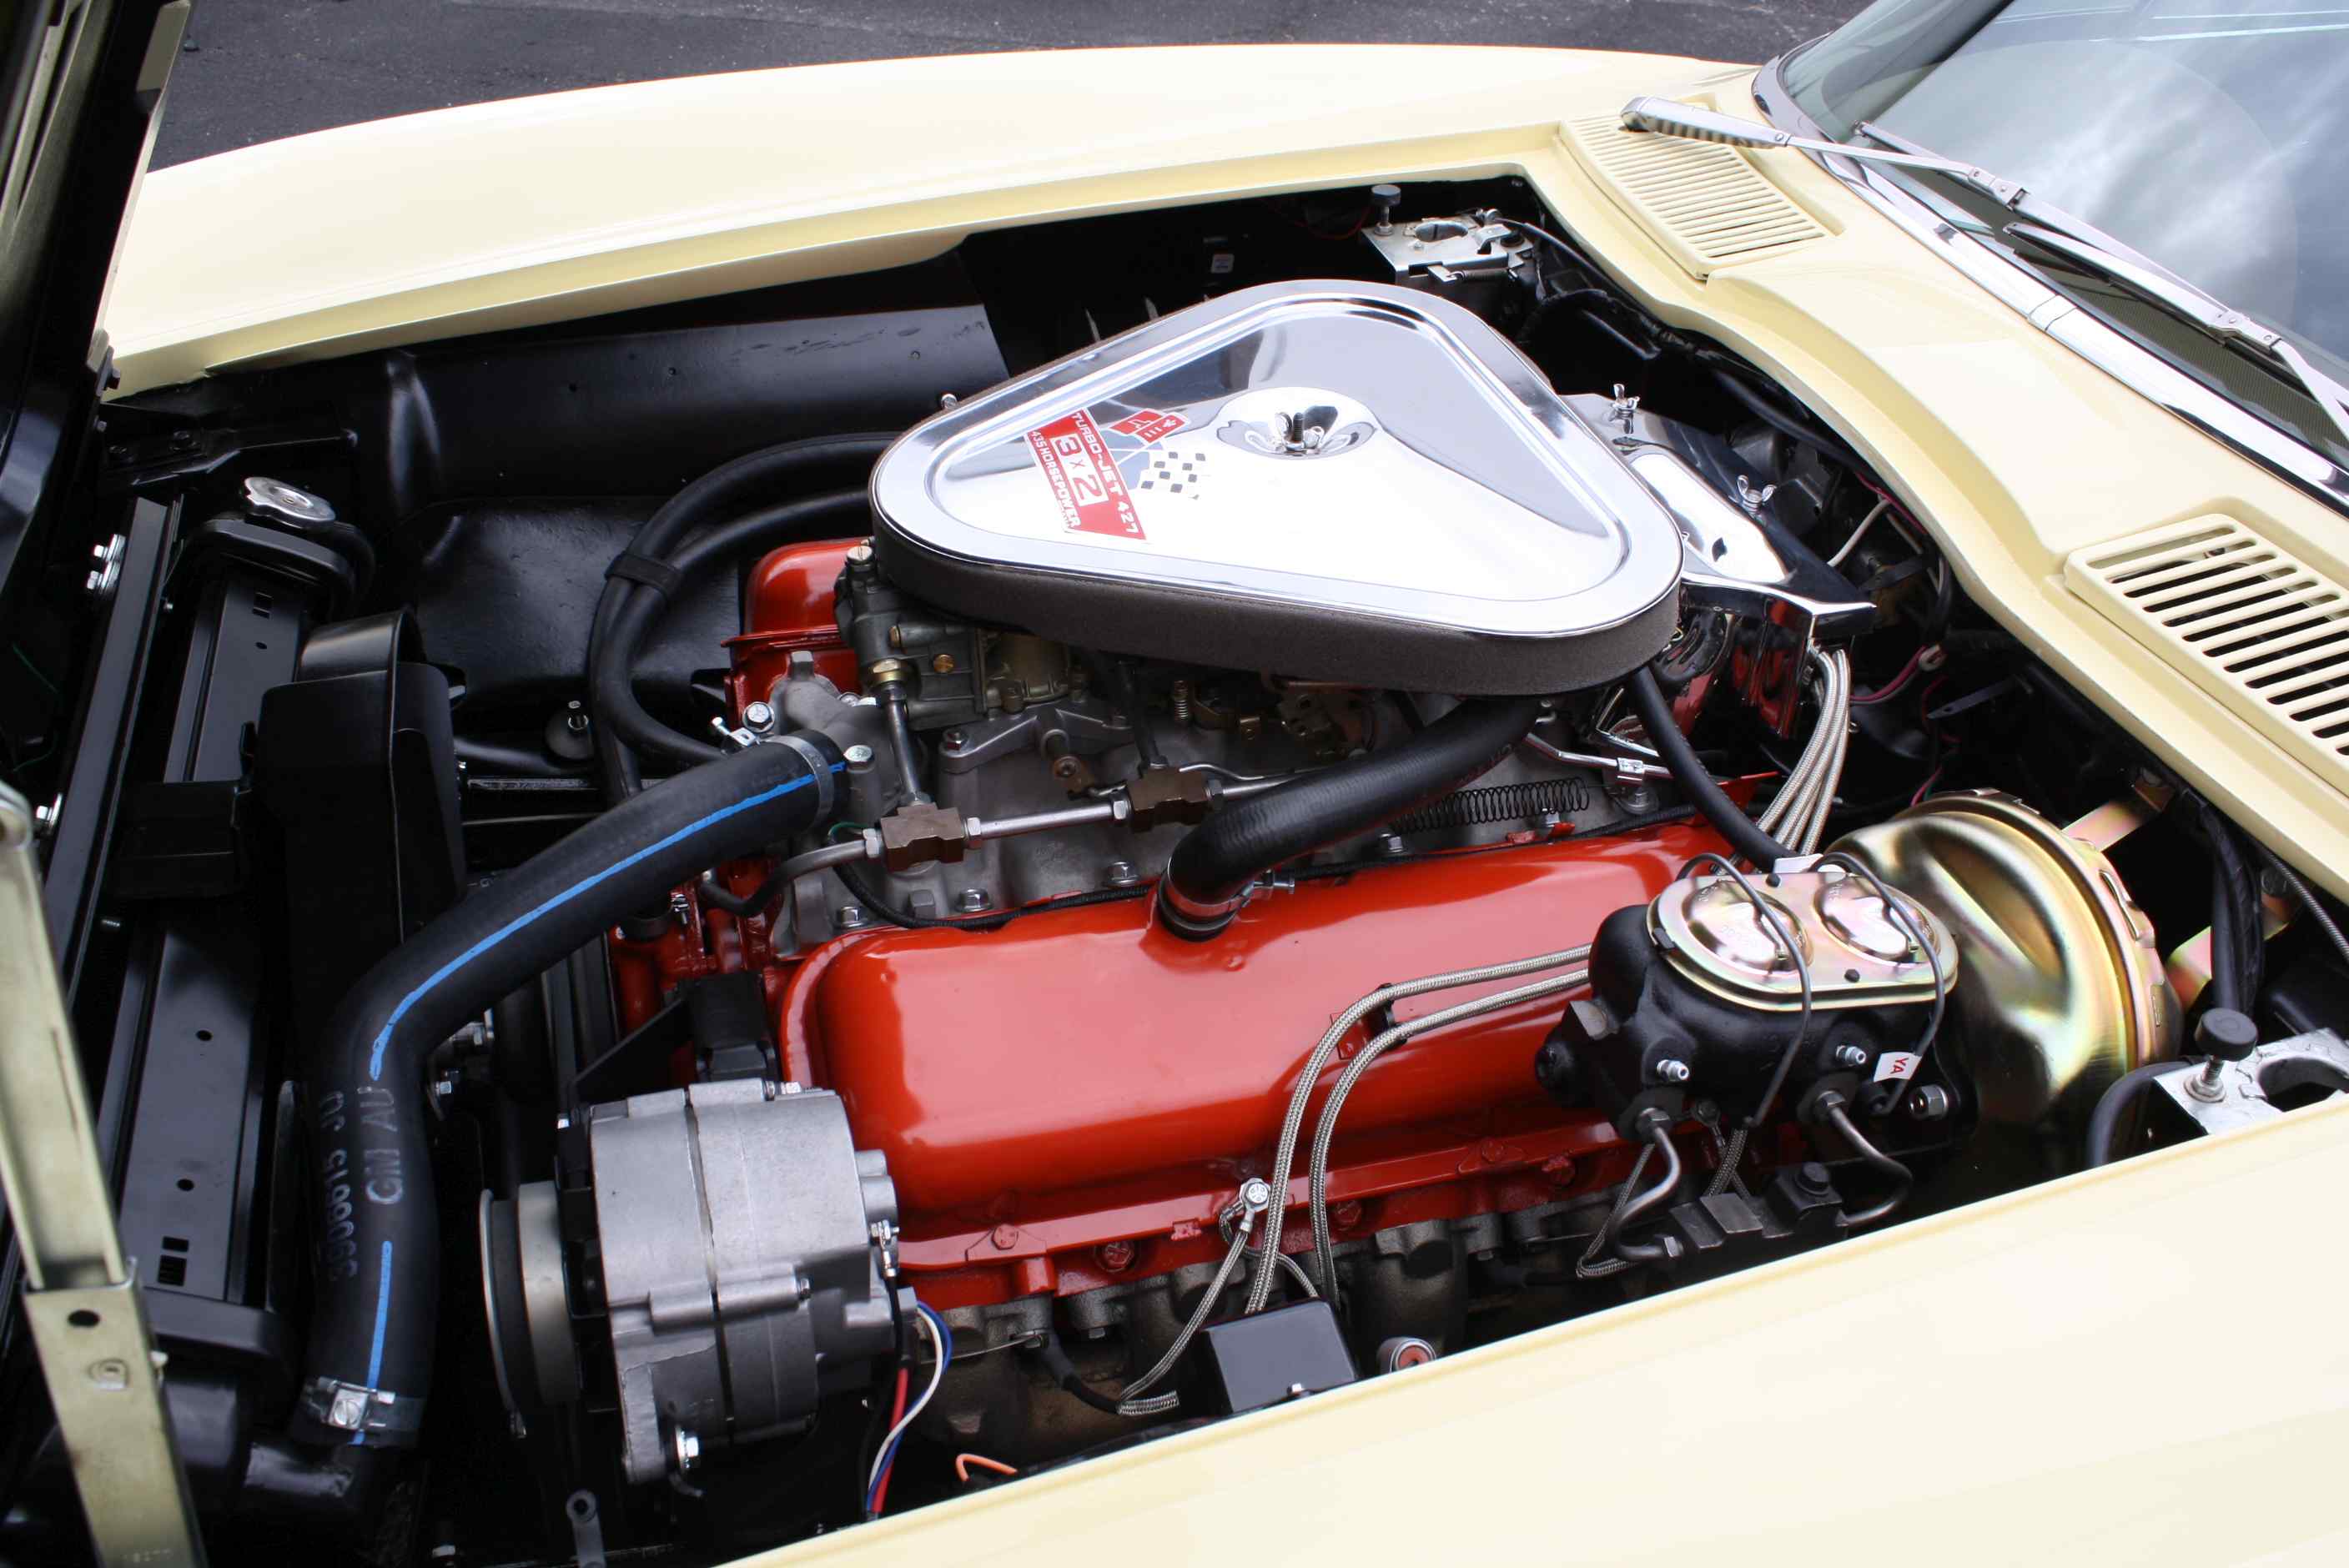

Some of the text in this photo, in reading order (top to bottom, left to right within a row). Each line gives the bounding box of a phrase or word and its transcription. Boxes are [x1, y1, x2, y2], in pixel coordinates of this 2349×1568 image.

[1030, 430, 1048, 448] 435
[1039, 446, 1081, 528] HORSEPOWER
[1072, 412, 1139, 534] TURBO-JET 427
